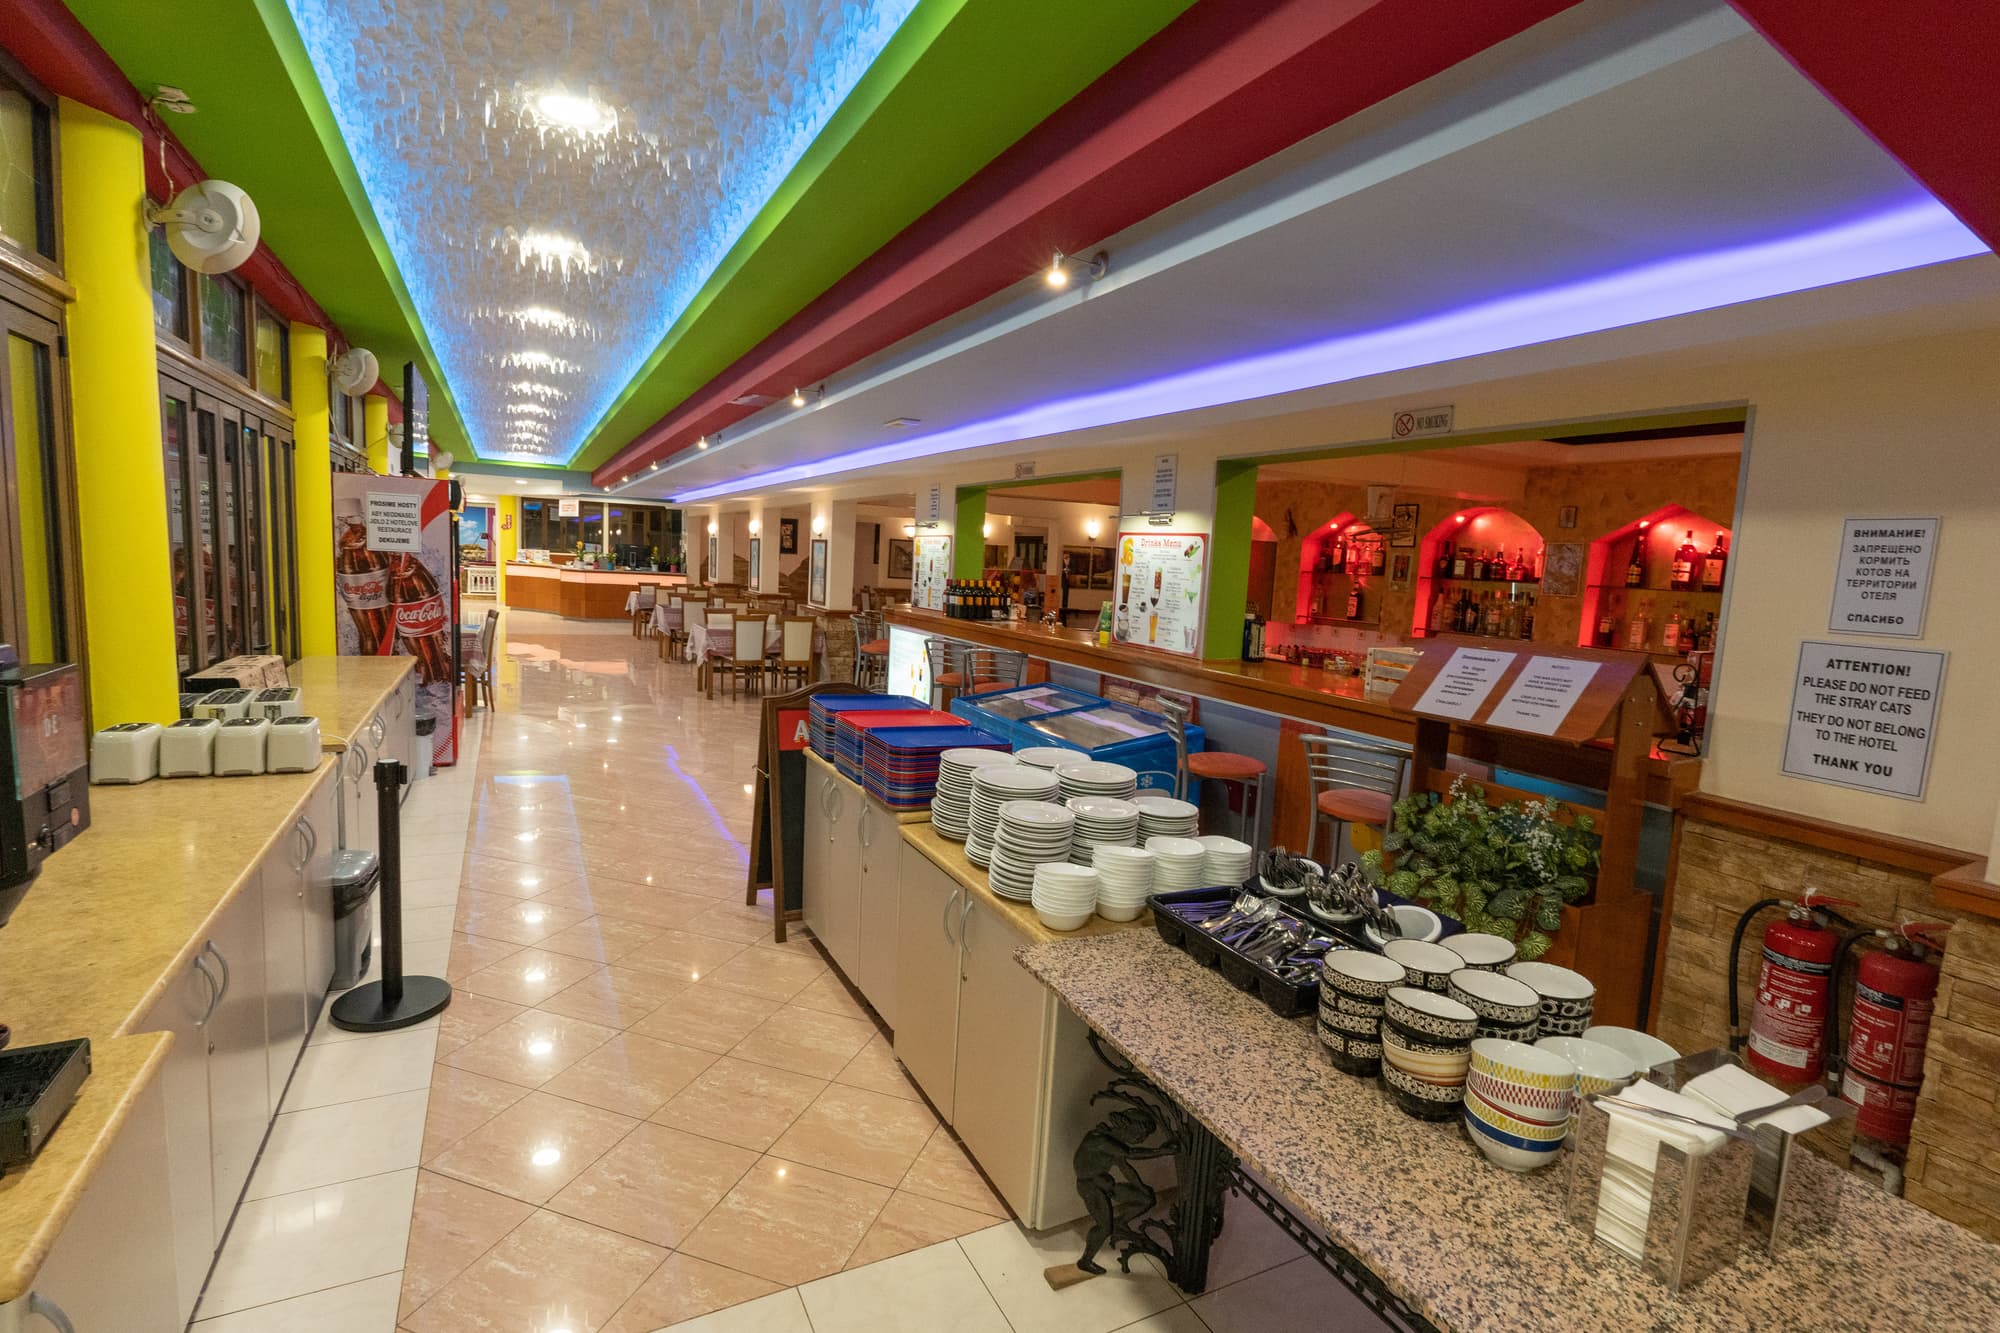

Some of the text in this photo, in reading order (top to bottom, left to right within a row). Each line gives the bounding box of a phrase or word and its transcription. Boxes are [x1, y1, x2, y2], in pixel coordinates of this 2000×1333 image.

[1854, 529, 1926, 538] ВНИМАНИЕ!
[1852, 544, 1922, 554] ЗАПРЕЩЕНО
[1859, 556, 1910, 565] КОРМИТЬ
[1856, 568, 1910, 577] КОТОВ НА
[1846, 579, 1917, 589] ТЕРРИТОРИИ
[1861, 591, 1897, 600] ОТЕЛЯ
[395, 602, 442, 624] Coca-Cola
[1847, 613, 1904, 624] СПАСИБО
[1825, 658, 1911, 677] ATTENTION!
[1802, 676, 1931, 701] PLEASE DO NOT FEED
[1815, 693, 1912, 715] THE STRAY CATS
[1797, 710, 1926, 739] THEY DO NOT BELONG
[1815, 729, 1898, 752] TO THE HOTEL
[1813, 753, 1893, 777] THANK YOU
